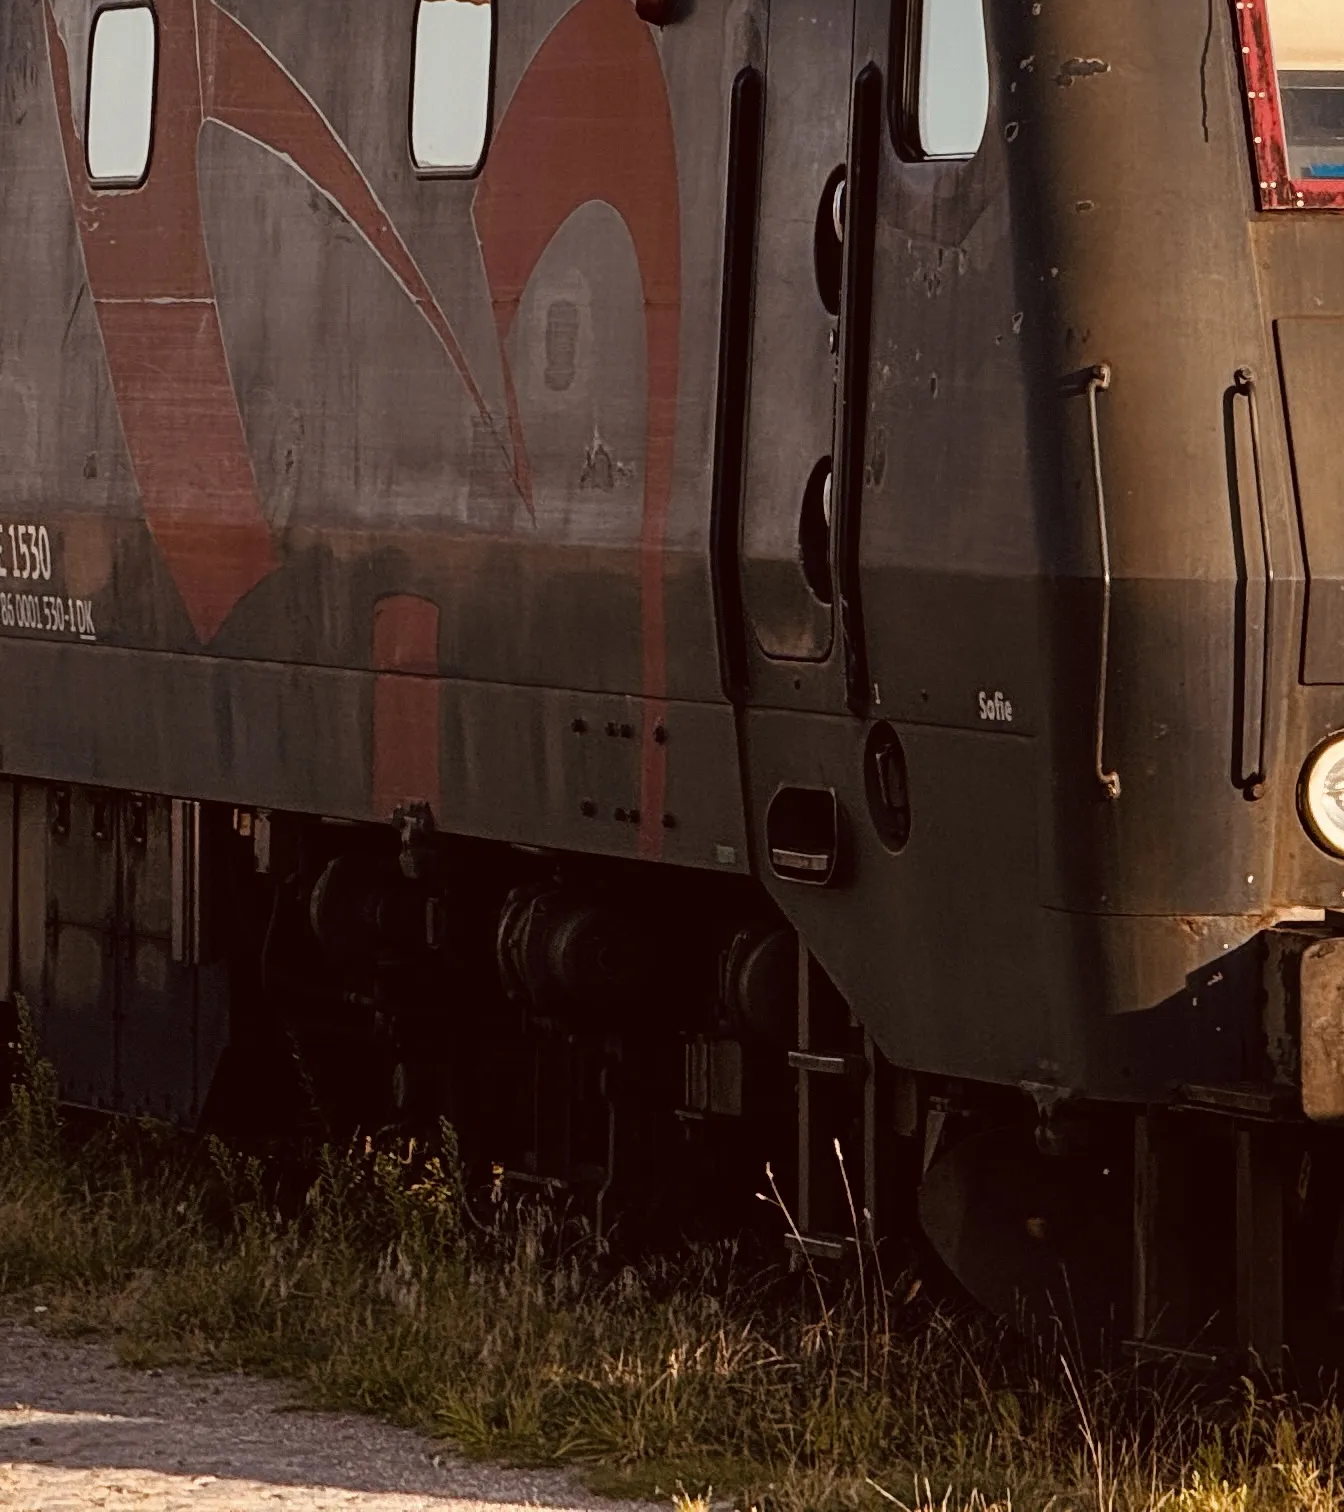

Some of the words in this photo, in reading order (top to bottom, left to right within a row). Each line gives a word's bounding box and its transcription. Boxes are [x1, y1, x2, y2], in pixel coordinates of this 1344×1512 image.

[8, 524, 52, 580] 1530
[0, 592, 16, 626] 86
[15, 594, 43, 629] 0001
[42, 596, 77, 632] 530-1
[76, 599, 96, 635] DK
[978, 691, 1013, 722] Sofie
